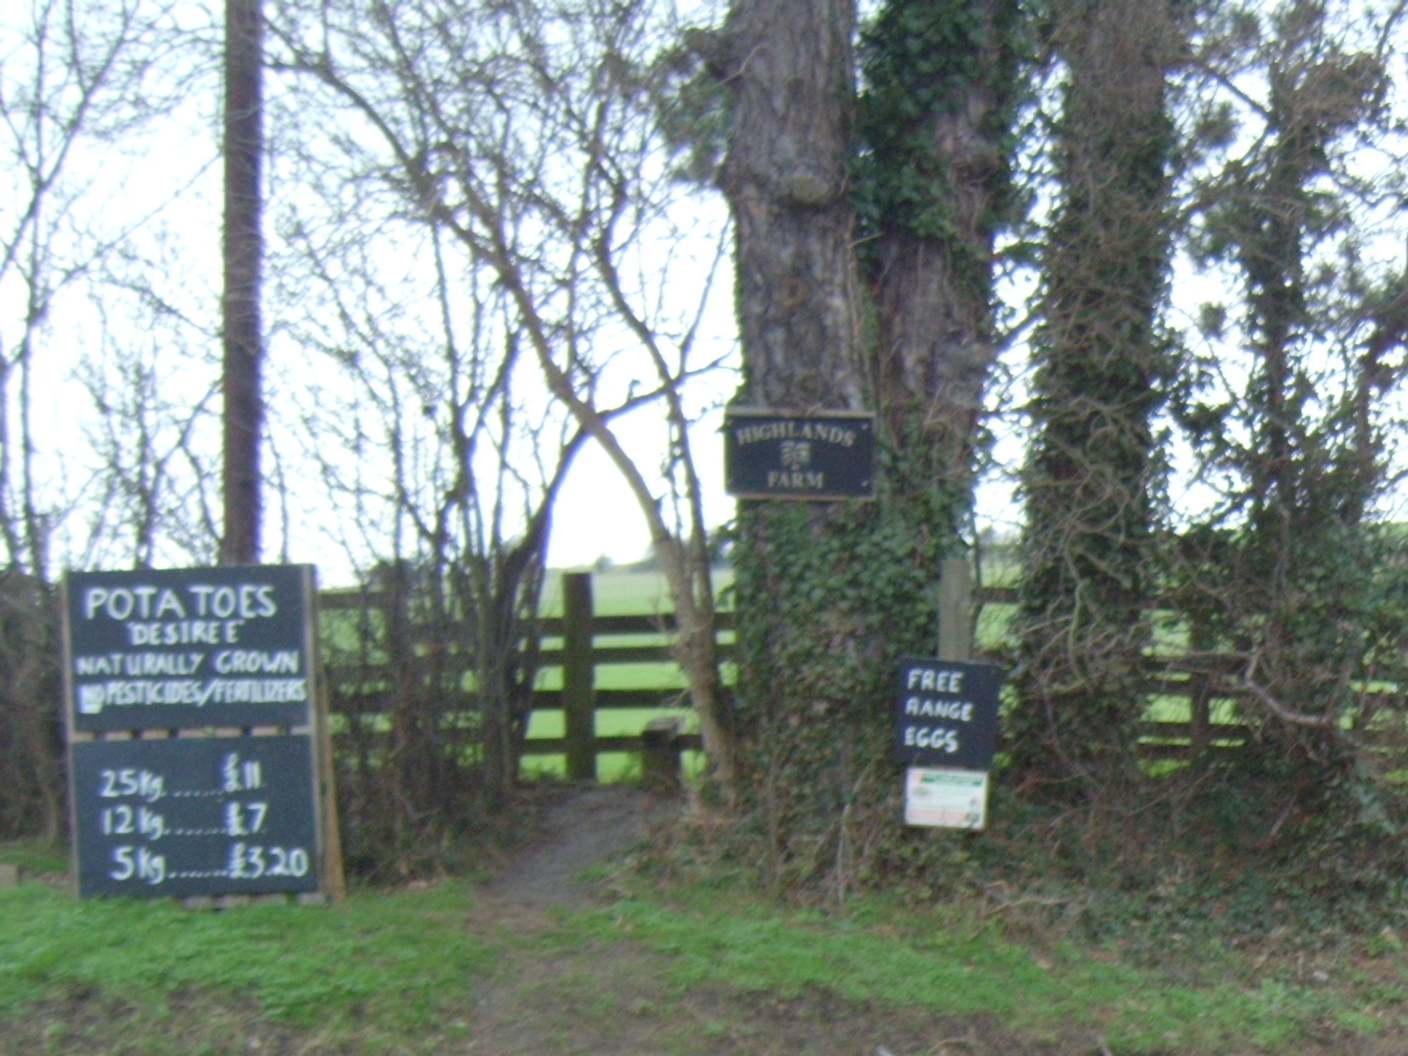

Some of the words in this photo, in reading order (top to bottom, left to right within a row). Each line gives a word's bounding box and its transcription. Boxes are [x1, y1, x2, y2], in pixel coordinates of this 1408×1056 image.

[736, 420, 857, 448] HIGHLANDS
[767, 470, 825, 489] FARM
[85, 584, 277, 620] POTATOES
[76, 652, 205, 675] NATURALLY
[214, 650, 299, 674] GROWN
[907, 668, 964, 693] FREE
[905, 698, 973, 722] RANGE
[904, 725, 959, 754] EGGS
